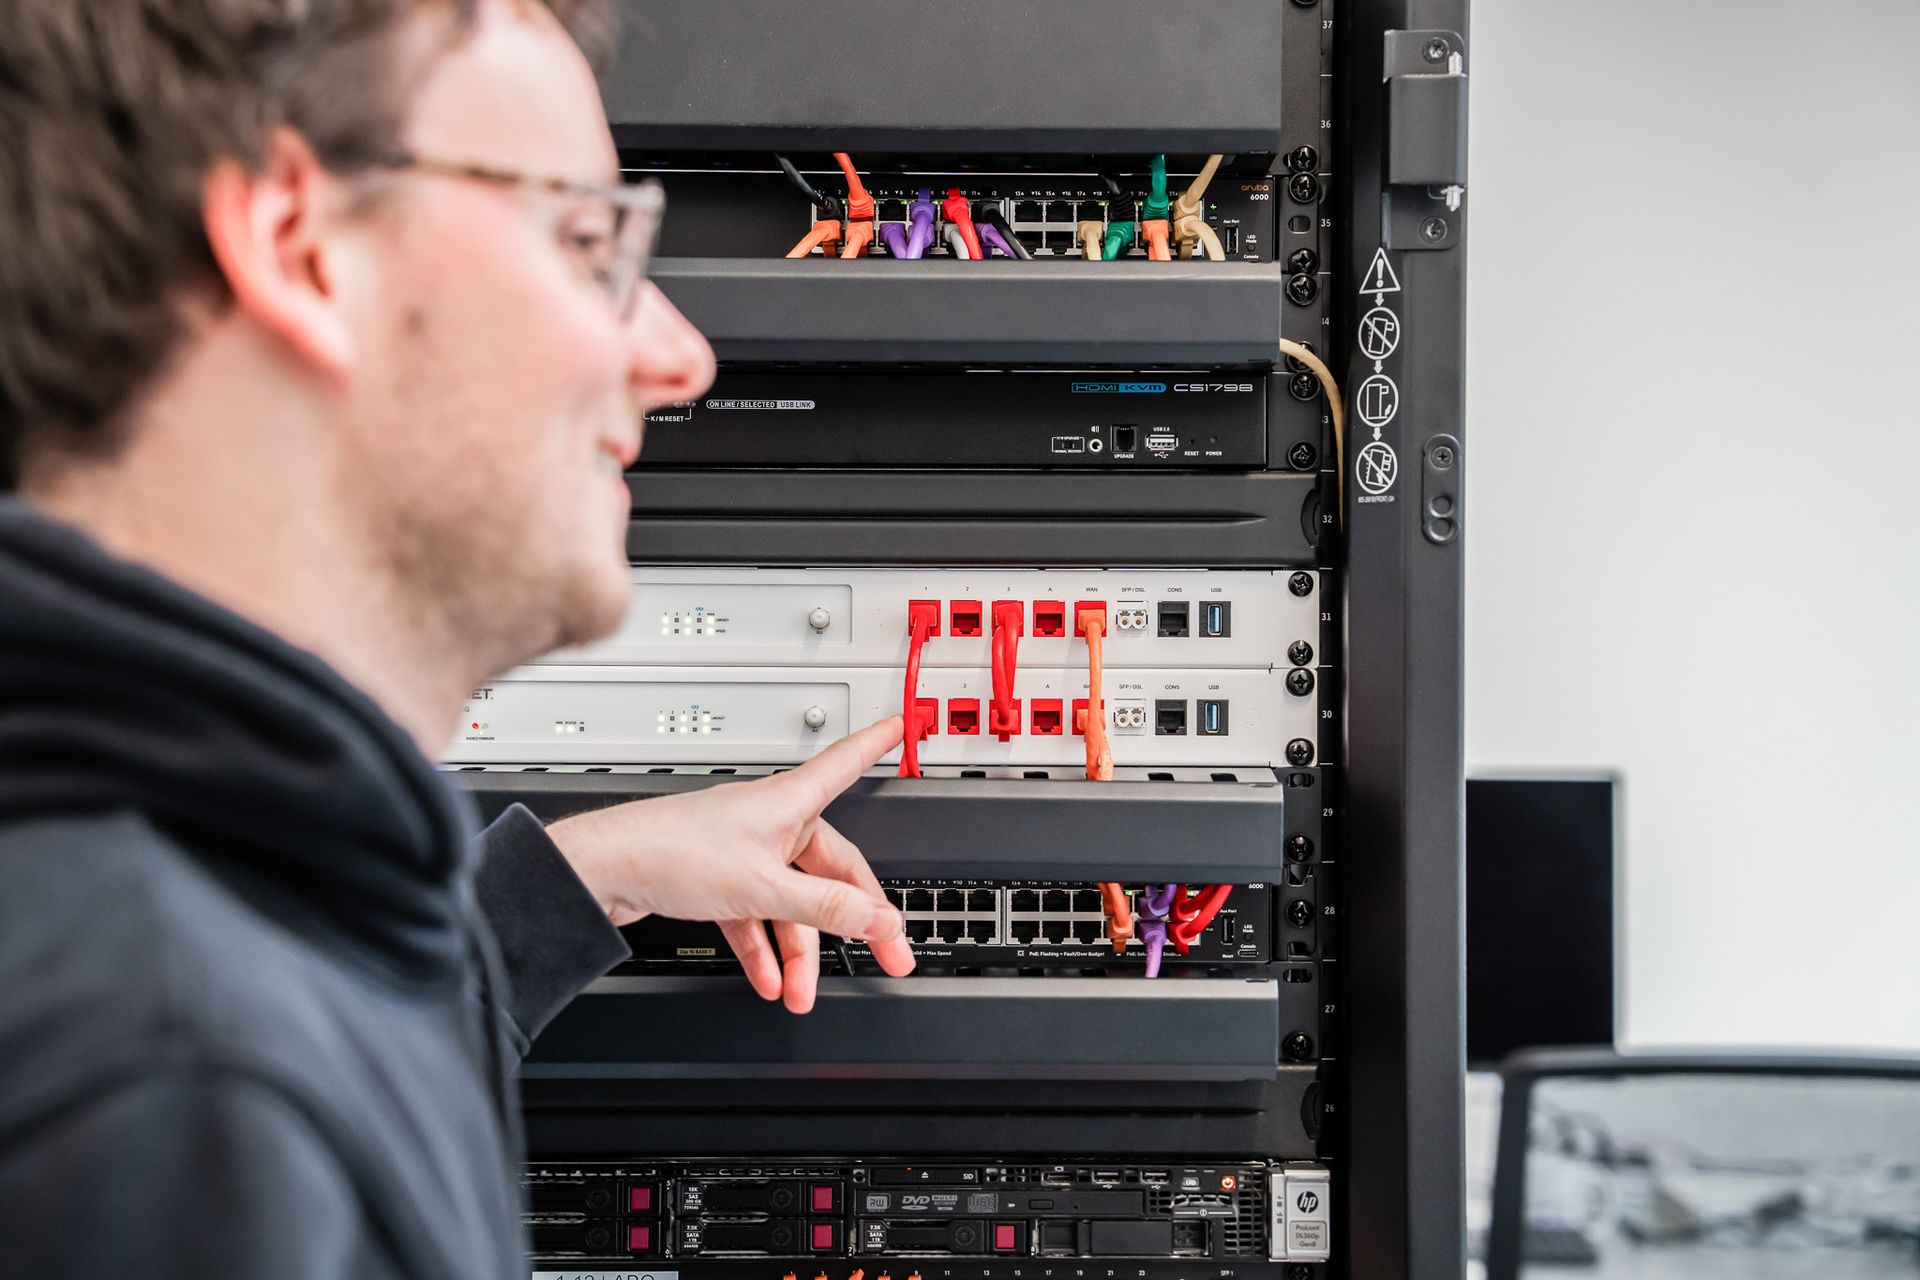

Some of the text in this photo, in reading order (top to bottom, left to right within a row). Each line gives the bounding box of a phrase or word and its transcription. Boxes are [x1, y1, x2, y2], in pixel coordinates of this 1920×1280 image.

[1322, 21, 1333, 29] 37
[1320, 120, 1331, 129] 36
[1320, 219, 1331, 228] 35
[1322, 317, 1329, 325] 4
[1173, 384, 1253, 392] CS1798
[1322, 515, 1333, 523] 32
[1321, 613, 1332, 622] 31
[1322, 710, 1332, 719] 30
[1323, 808, 1333, 816] 29
[1325, 906, 1335, 915] 28
[1325, 1005, 1335, 1013] 27
[1325, 1104, 1335, 1113] 26
[870, 1198, 884, 1207] RW
[902, 1195, 930, 1205] DVD
[1299, 1191, 1317, 1213] hp
